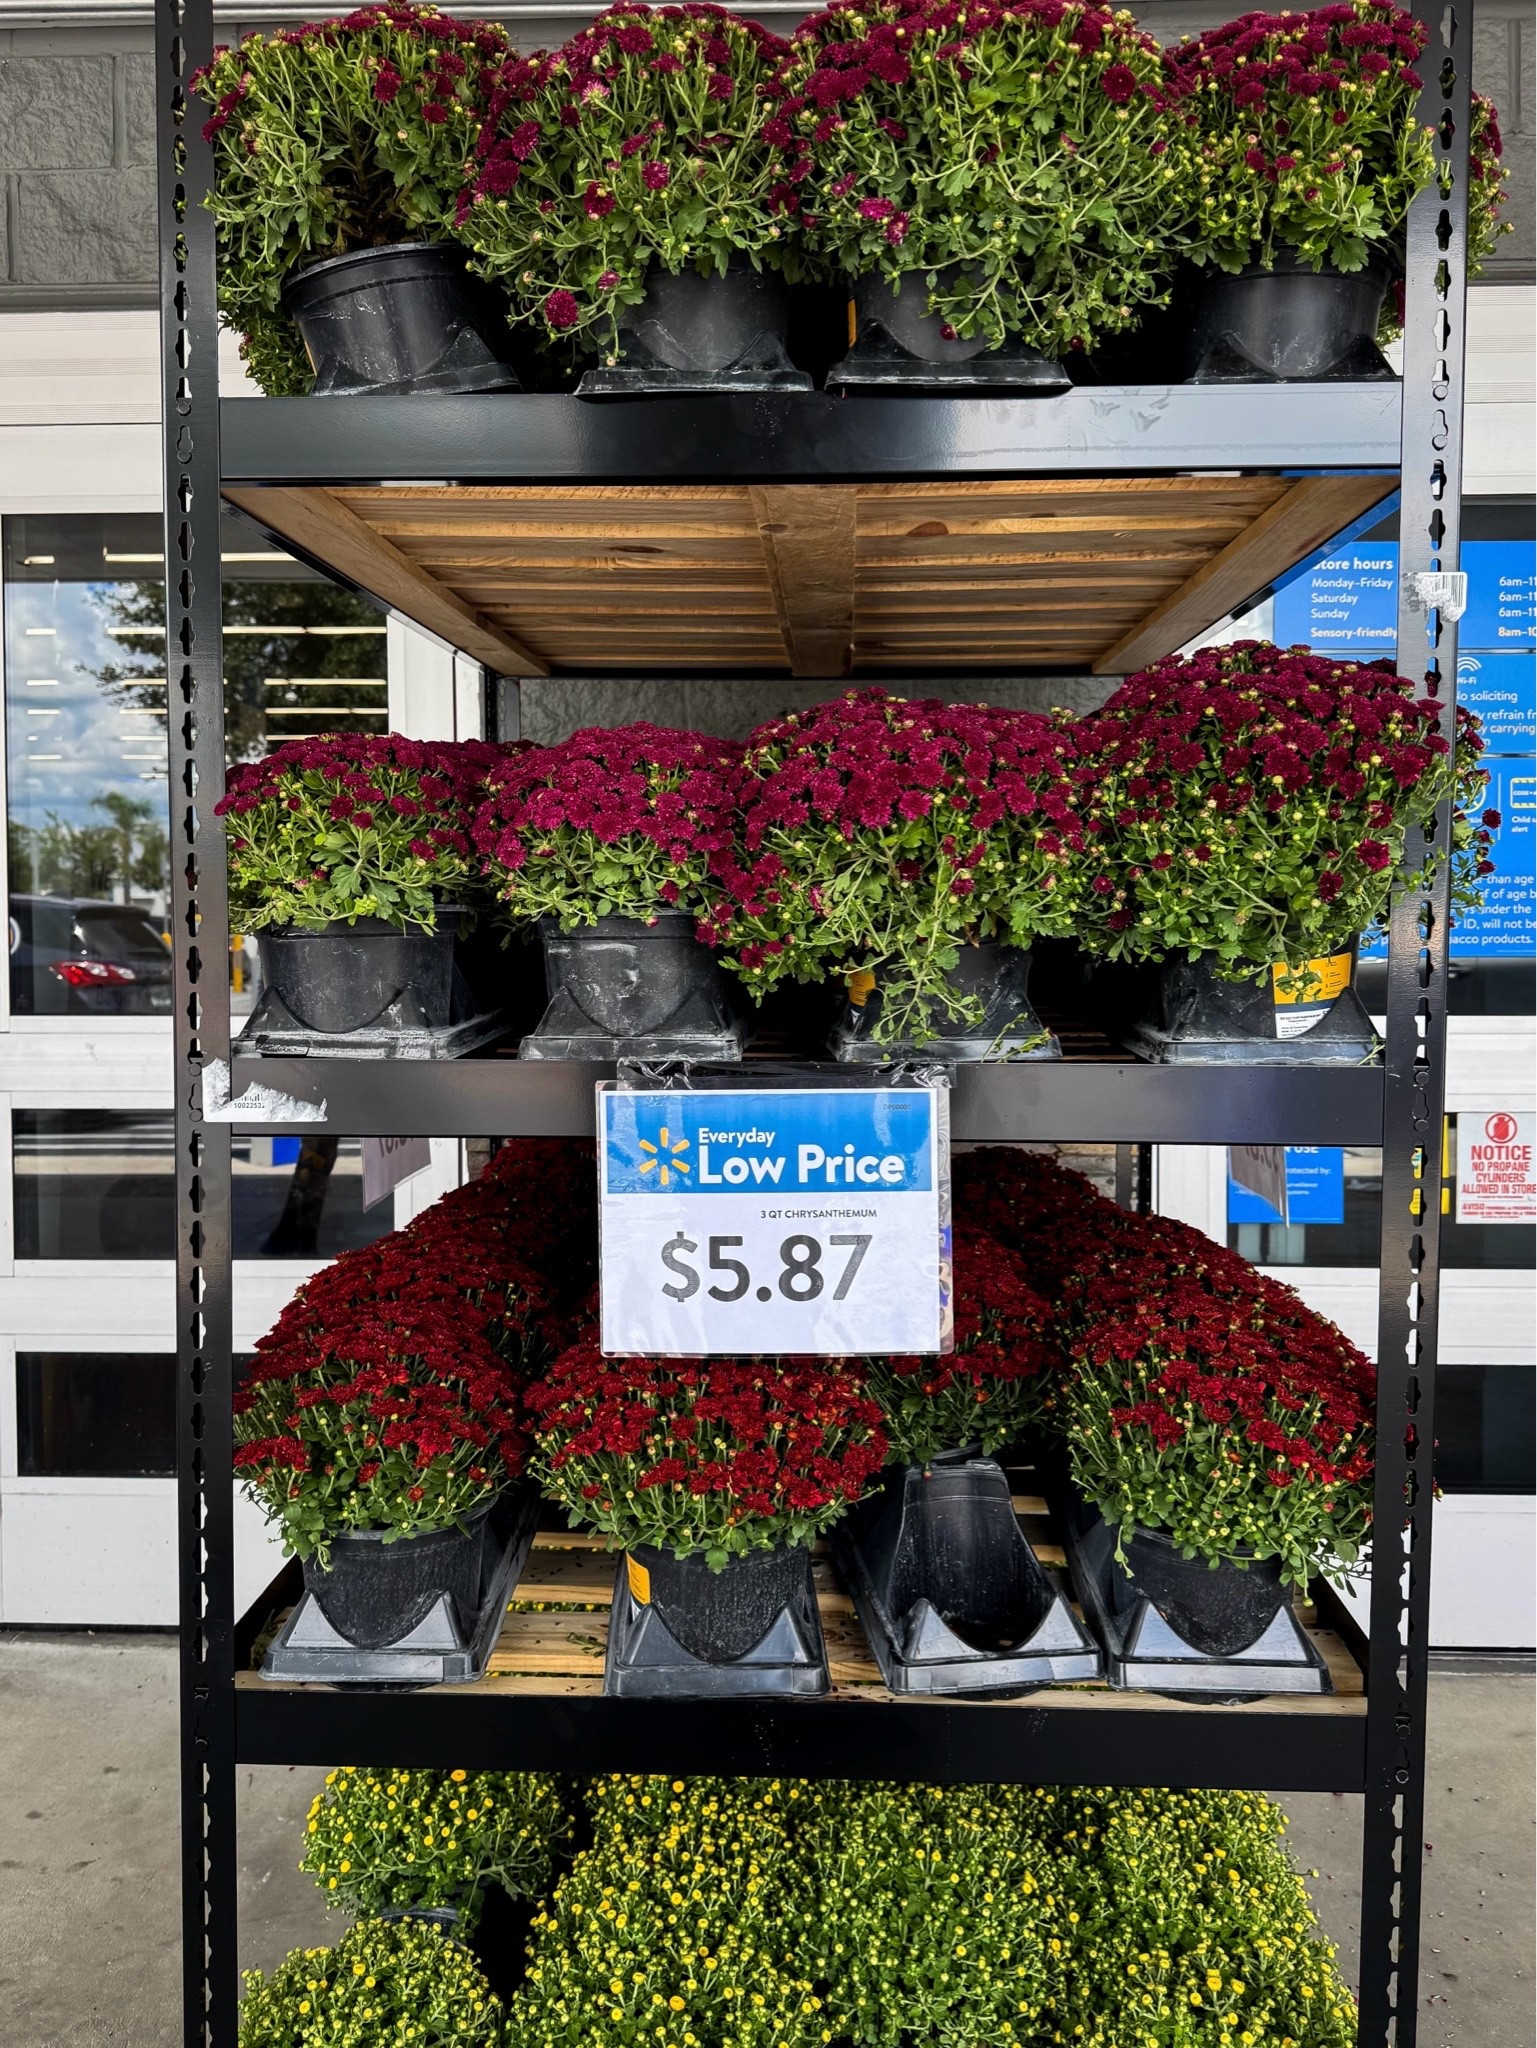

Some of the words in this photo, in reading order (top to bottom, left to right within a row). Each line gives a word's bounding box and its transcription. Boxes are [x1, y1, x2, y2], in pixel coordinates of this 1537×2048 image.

[1353, 557, 1393, 570] hours
[1311, 578, 1393, 590] Monday–Friday
[1311, 593, 1358, 606] Saturday
[1310, 608, 1350, 621] Sunday
[1310, 627, 1397, 640] Sensory-friendly
[1470, 690, 1518, 704] soliciting
[1487, 709, 1525, 720] refrain
[1490, 722, 1536, 736] carrying
[1487, 874, 1512, 885] than
[1513, 875, 1534, 887] age
[1491, 888, 1506, 899] of
[1506, 890, 1528, 902] age
[1513, 904, 1532, 914] the
[1463, 919, 1480, 930] ID,
[1482, 918, 1501, 929] will
[1503, 919, 1523, 929] not
[1481, 933, 1534, 947] products.
[698, 1126, 776, 1148] Everyday
[1470, 1145, 1532, 1161] NOTICE
[699, 1145, 787, 1185] Low
[797, 1143, 905, 1183] Price
[1471, 1162, 1485, 1172] NO
[1487, 1162, 1530, 1172] PROPANE
[1475, 1172, 1526, 1183] CYLINDERS
[1461, 1183, 1499, 1194] ALLOWED
[1500, 1183, 1510, 1194] IN
[1511, 1183, 1537, 1194] STORE
[760, 1210, 767, 1219] 3
[768, 1210, 783, 1219] QT
[784, 1208, 877, 1219] CHRYSANTHEMUM
[1461, 1203, 1485, 1211] AVISO
[660, 1231, 874, 1303] $5.87
